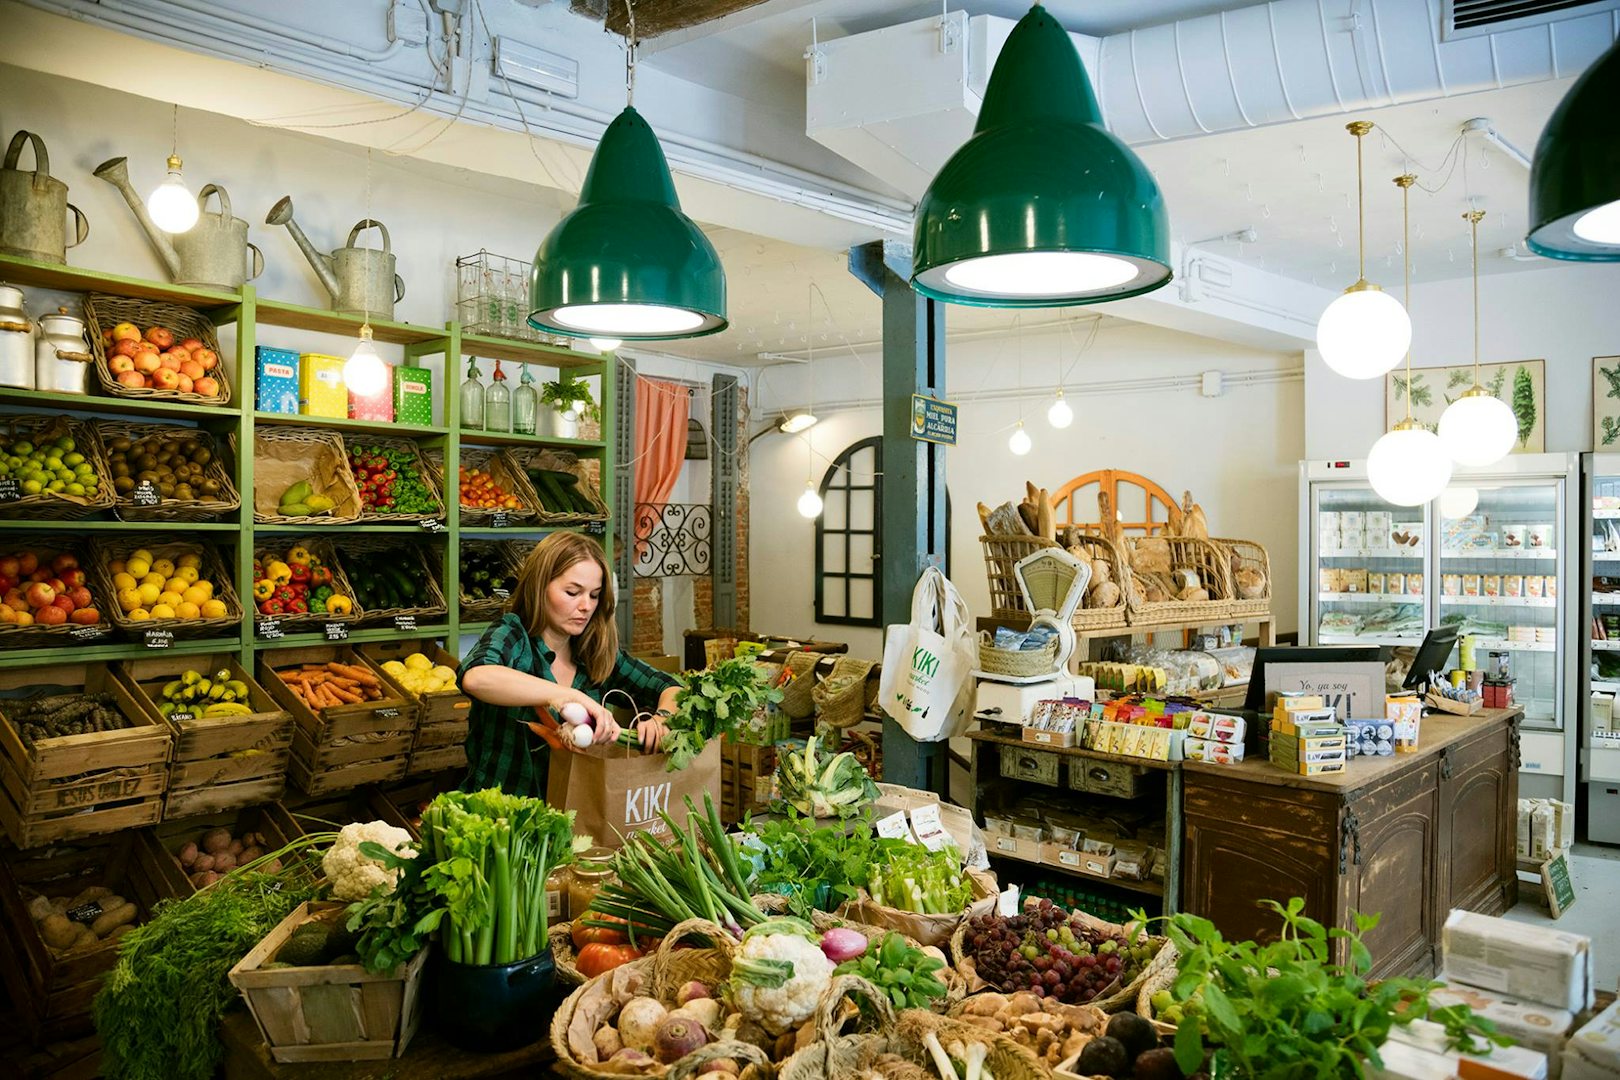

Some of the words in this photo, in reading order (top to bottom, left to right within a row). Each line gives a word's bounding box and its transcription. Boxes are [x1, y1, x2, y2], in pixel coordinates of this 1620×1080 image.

[268, 367, 290, 375] PASTA
[926, 410, 939, 421] MIEL
[940, 414, 956, 424] PURA
[911, 645, 940, 678] KIKI
[1299, 680, 1315, 691] Yo,
[1316, 683, 1330, 692] ya
[1332, 683, 1348, 692] soy
[625, 782, 672, 824] KIKI
[625, 820, 668, 840] mrket
